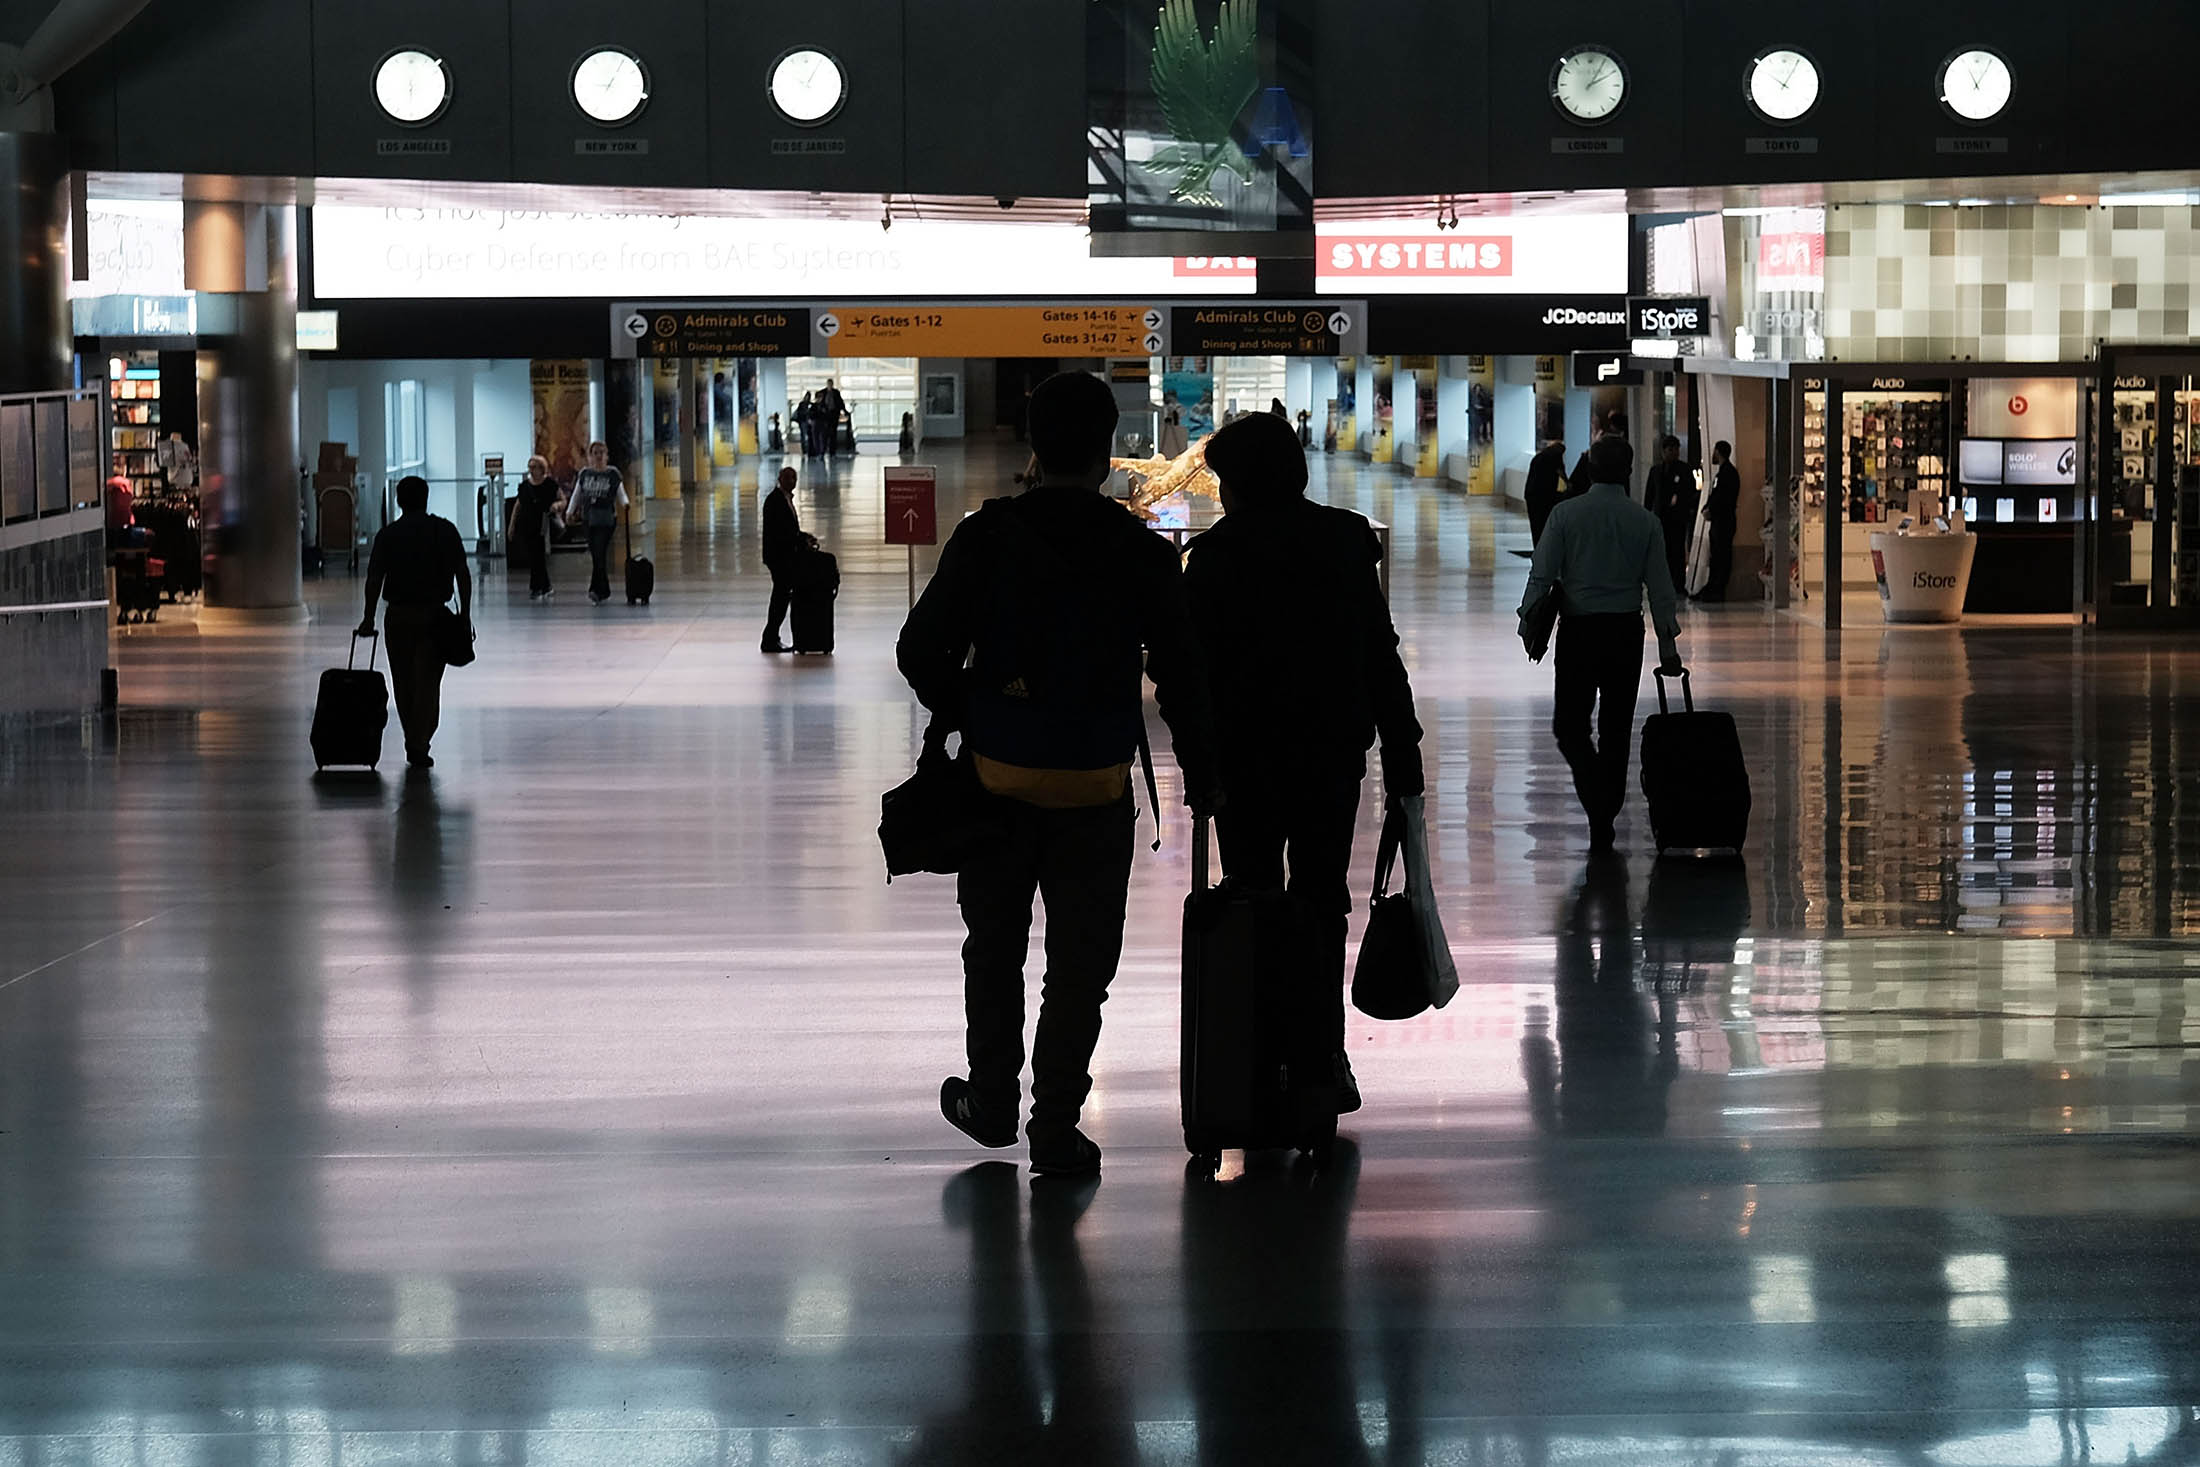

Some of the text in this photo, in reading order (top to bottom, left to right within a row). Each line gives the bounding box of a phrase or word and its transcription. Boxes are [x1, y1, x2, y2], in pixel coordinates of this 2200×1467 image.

[380, 142, 447, 152] LOS ANGELES
[585, 142, 638, 152] NEW YORK
[1568, 141, 1608, 150] LONDON
[1765, 141, 1800, 151] TOKYO
[1953, 141, 1991, 151] SYDNEY
[386, 242, 904, 280] Cyber Defense from BAE Systems
[1331, 243, 1501, 269] SYSTEMS
[684, 314, 787, 327] Admirals Club
[870, 315, 942, 327] Gates 1-12
[1042, 310, 1117, 321] Gates 14-16
[1194, 310, 1296, 323] Admirals Club
[1542, 308, 1625, 324] JCDecaux
[1641, 308, 1698, 330] iStore
[1042, 333, 1117, 344] Gates 31-47
[687, 342, 779, 353] Dining and Shops
[1202, 339, 1293, 351] Dining and Shops
[1872, 378, 1905, 389] Audio
[2113, 376, 2146, 388] Audio
[1912, 571, 1956, 589] iStore
